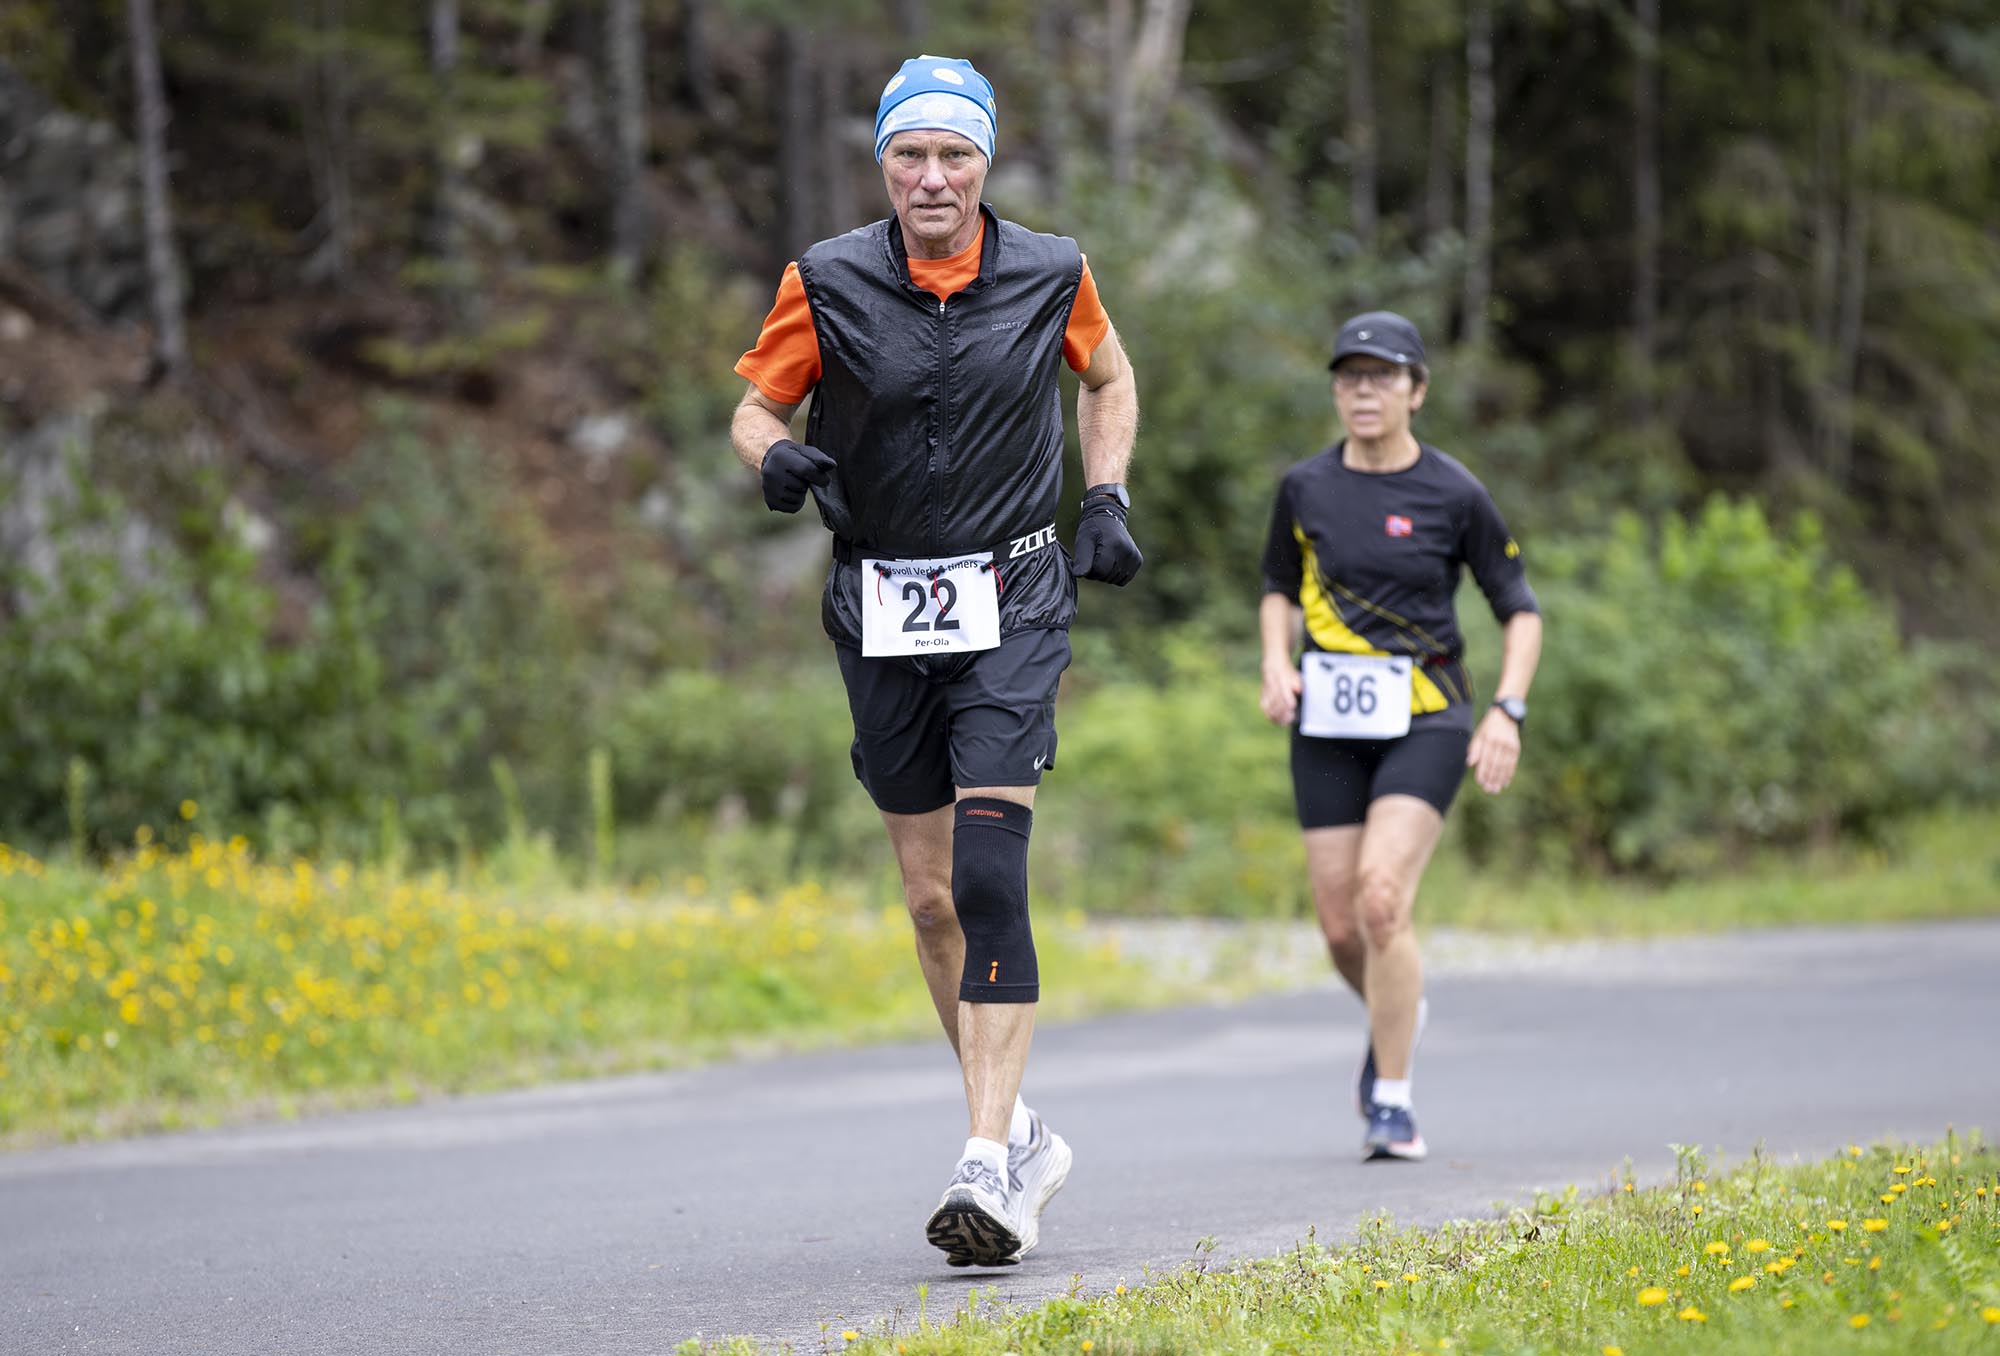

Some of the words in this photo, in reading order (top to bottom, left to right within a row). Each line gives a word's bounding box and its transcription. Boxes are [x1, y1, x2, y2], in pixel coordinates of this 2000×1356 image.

[902, 578, 960, 632] 22
[915, 638, 950, 647] Per-Ola
[1333, 674, 1377, 715] 86
